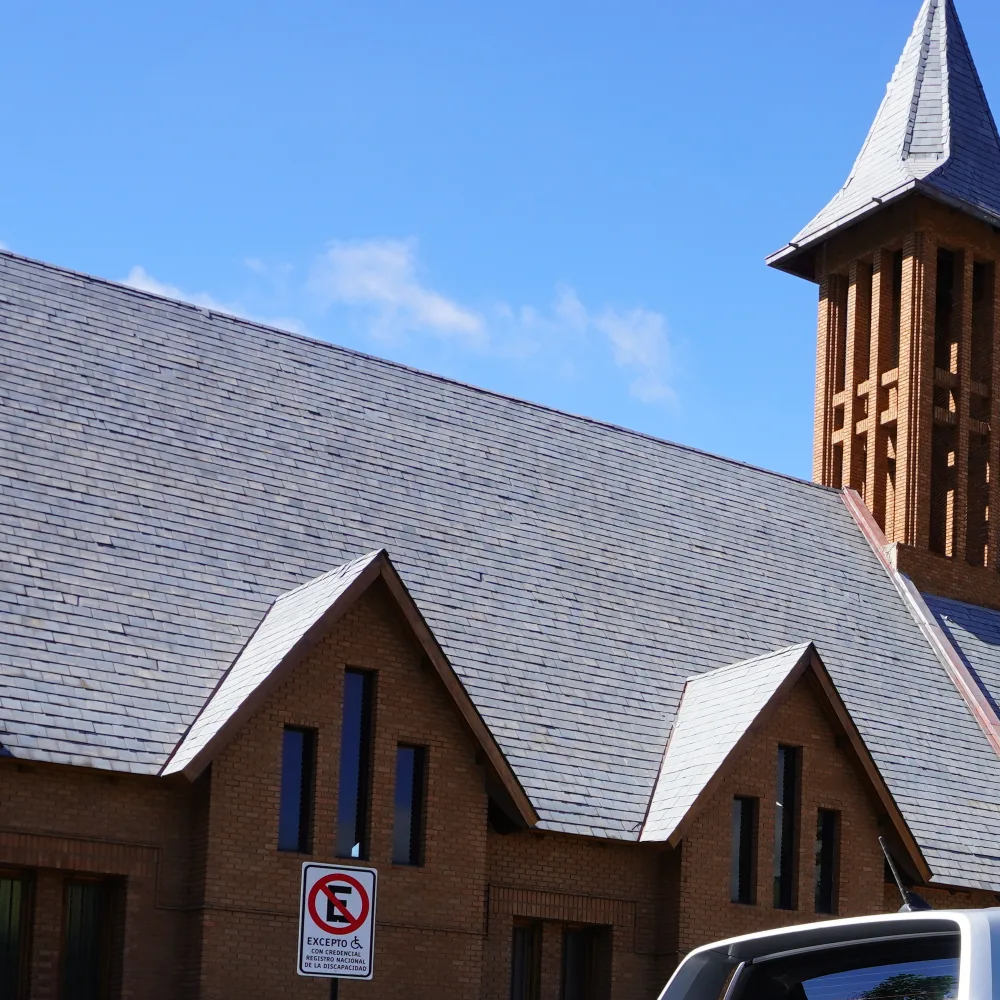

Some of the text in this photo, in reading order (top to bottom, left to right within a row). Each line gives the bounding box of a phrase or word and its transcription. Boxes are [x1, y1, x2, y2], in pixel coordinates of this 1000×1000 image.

[326, 884, 352, 923] E
[307, 936, 348, 948] EXCEPTO
[325, 949, 361, 958] CREDENCIAL
[336, 957, 366, 965] NACIONAL
[323, 963, 367, 972] DISCAPACIDAD
